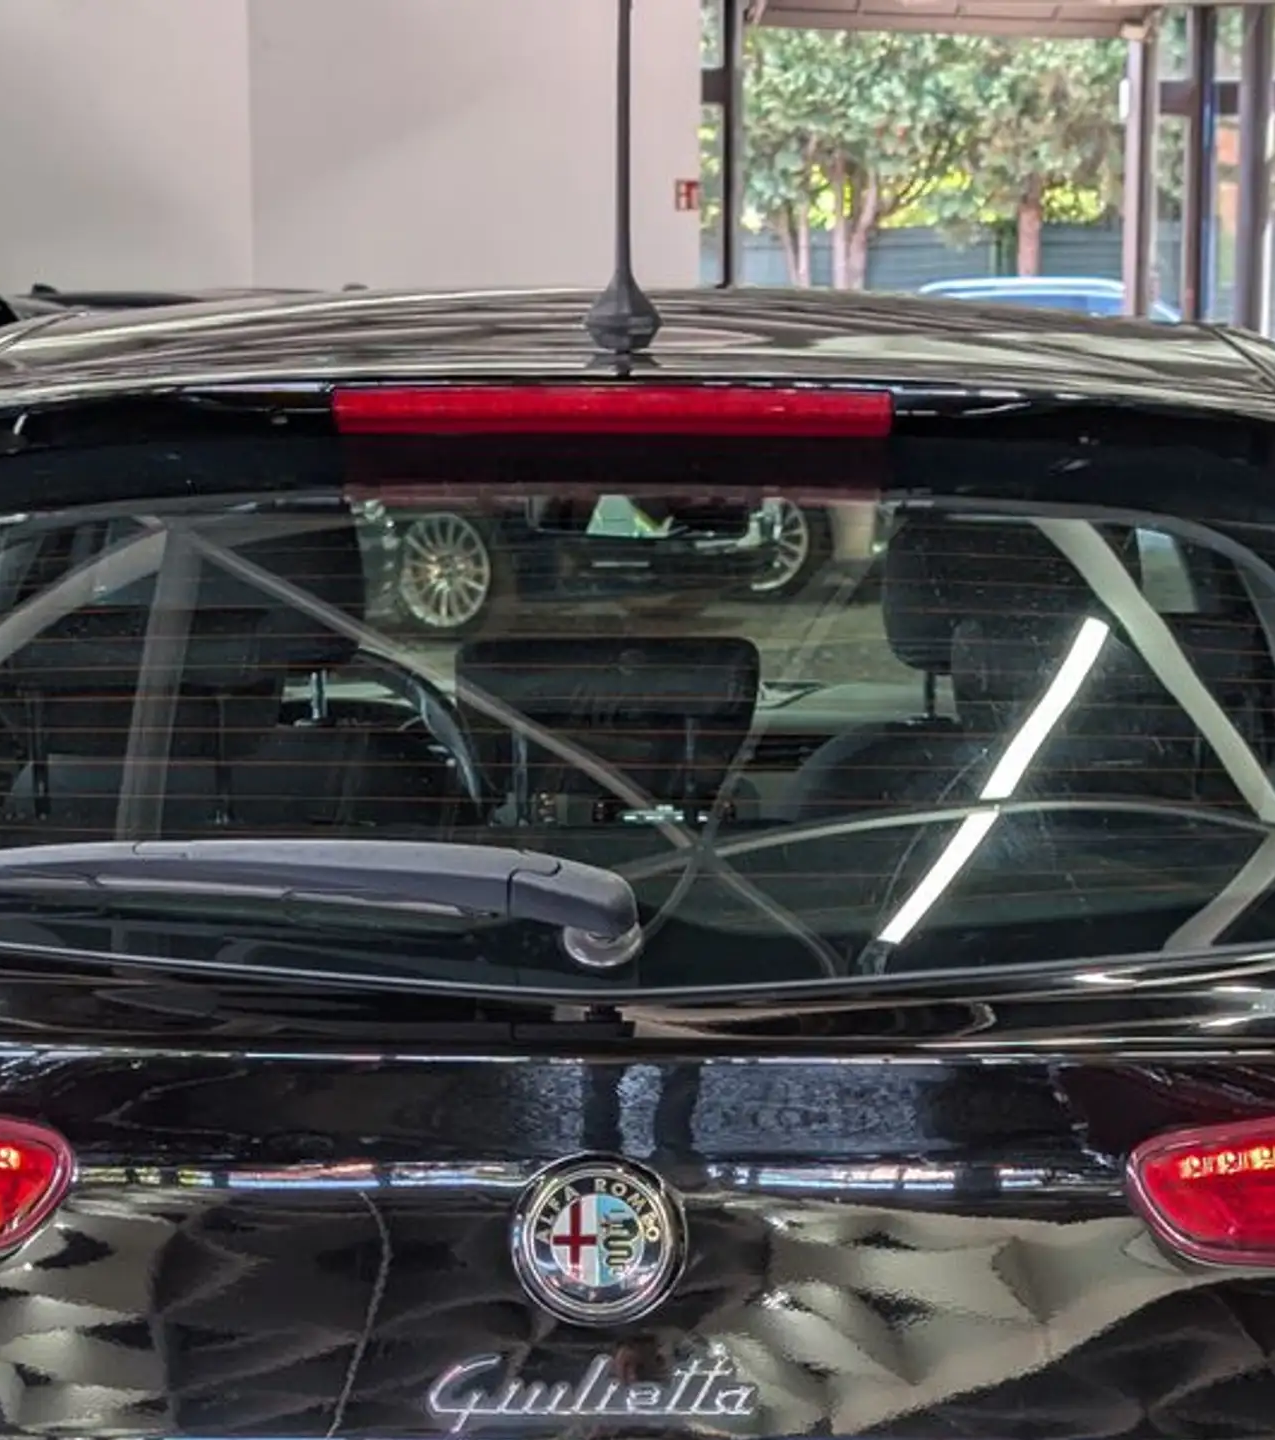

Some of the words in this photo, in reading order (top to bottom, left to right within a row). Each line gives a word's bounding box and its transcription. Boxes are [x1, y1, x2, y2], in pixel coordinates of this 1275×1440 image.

[536, 1185, 580, 1244] ALFA
[594, 1178, 660, 1242] ROMEO
[429, 1353, 756, 1433] Giulietta
